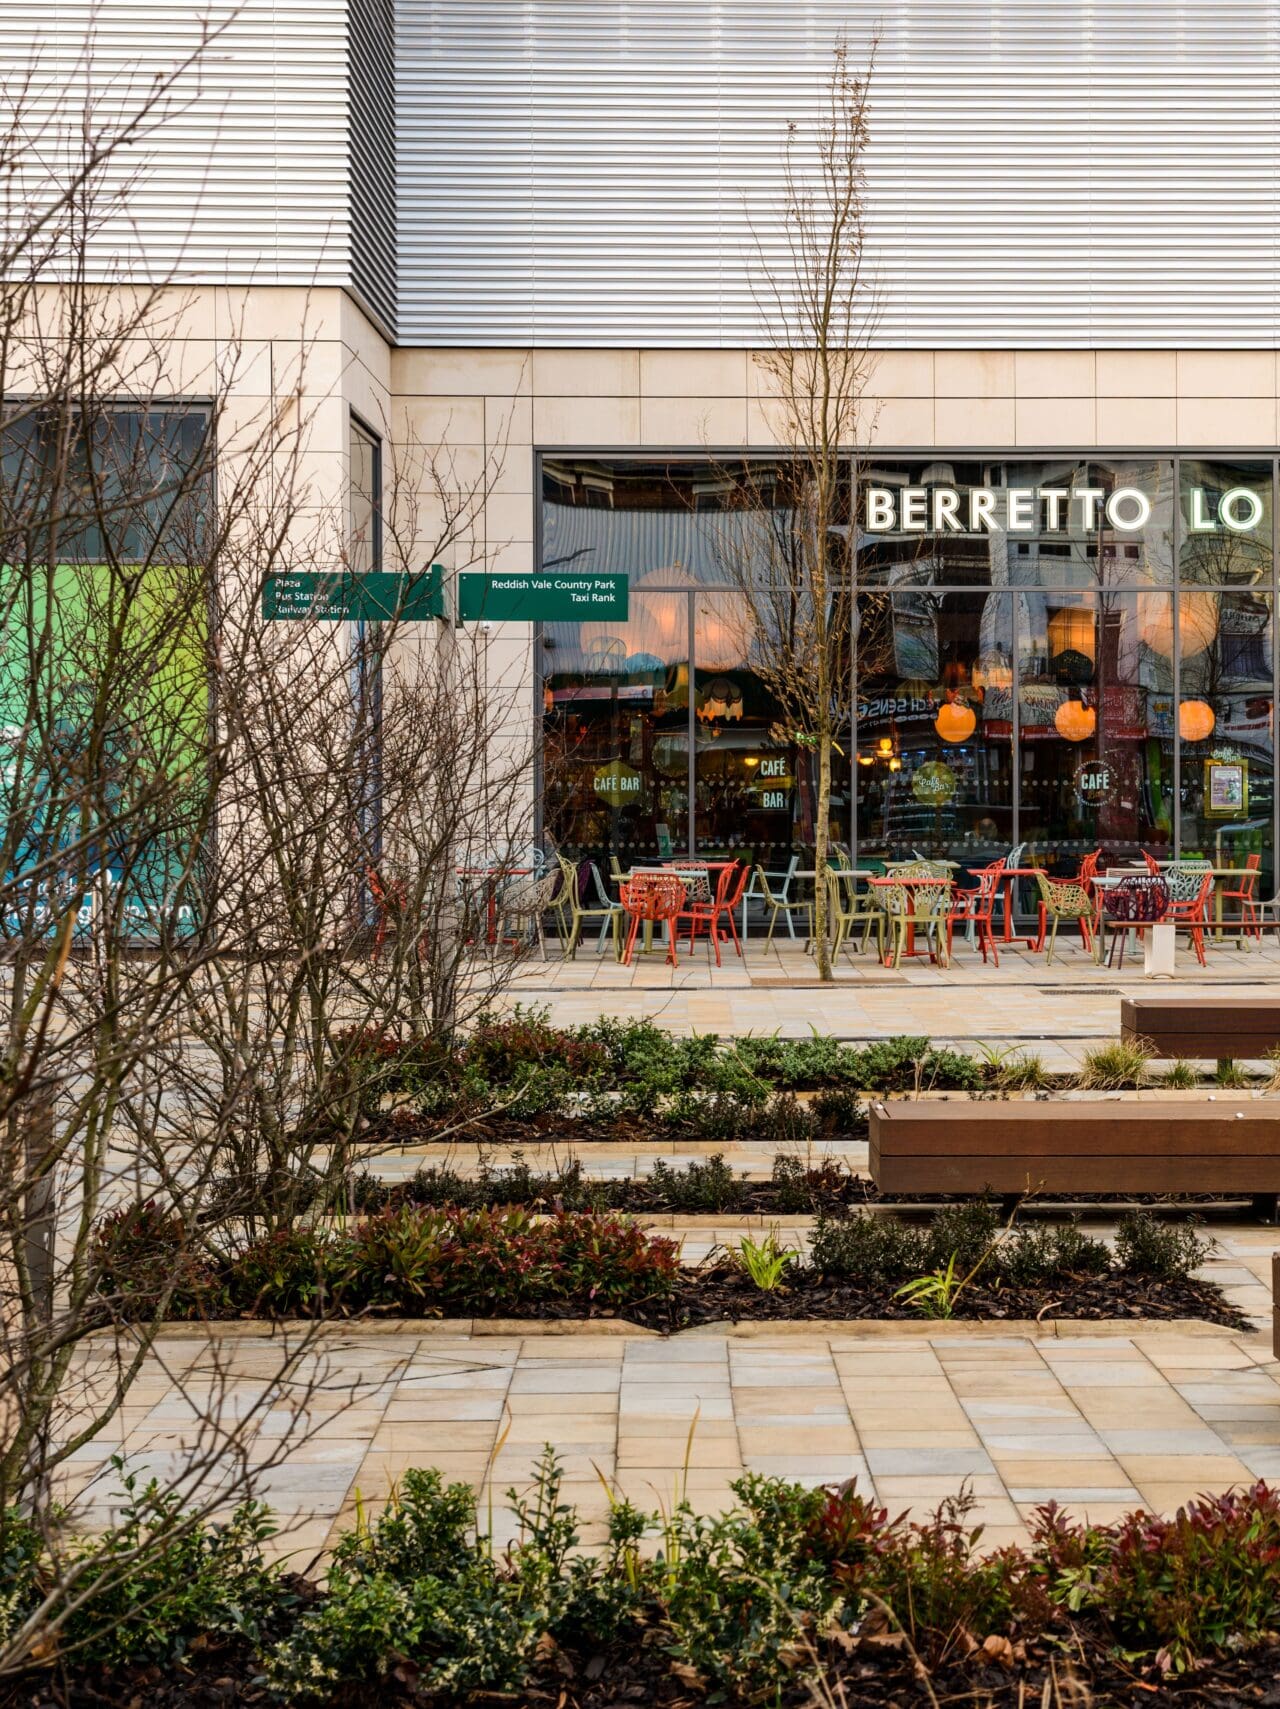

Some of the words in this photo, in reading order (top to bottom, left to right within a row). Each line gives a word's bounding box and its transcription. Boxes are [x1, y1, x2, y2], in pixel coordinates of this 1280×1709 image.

[866, 487, 1150, 532] BERRETTO
[491, 580, 528, 589] Reddish
[531, 580, 552, 589] Vale
[554, 580, 592, 591] Country
[594, 580, 616, 589] Park
[294, 591, 329, 601] Station
[570, 593, 590, 602] Taxi
[592, 593, 616, 602] Rank
[761, 757, 786, 776] CAFÉ
[593, 774, 617, 791] CAFÉ
[620, 777, 640, 791] BAR
[1081, 769, 1110, 790] CAFÉ
[763, 792, 784, 808] BAR
